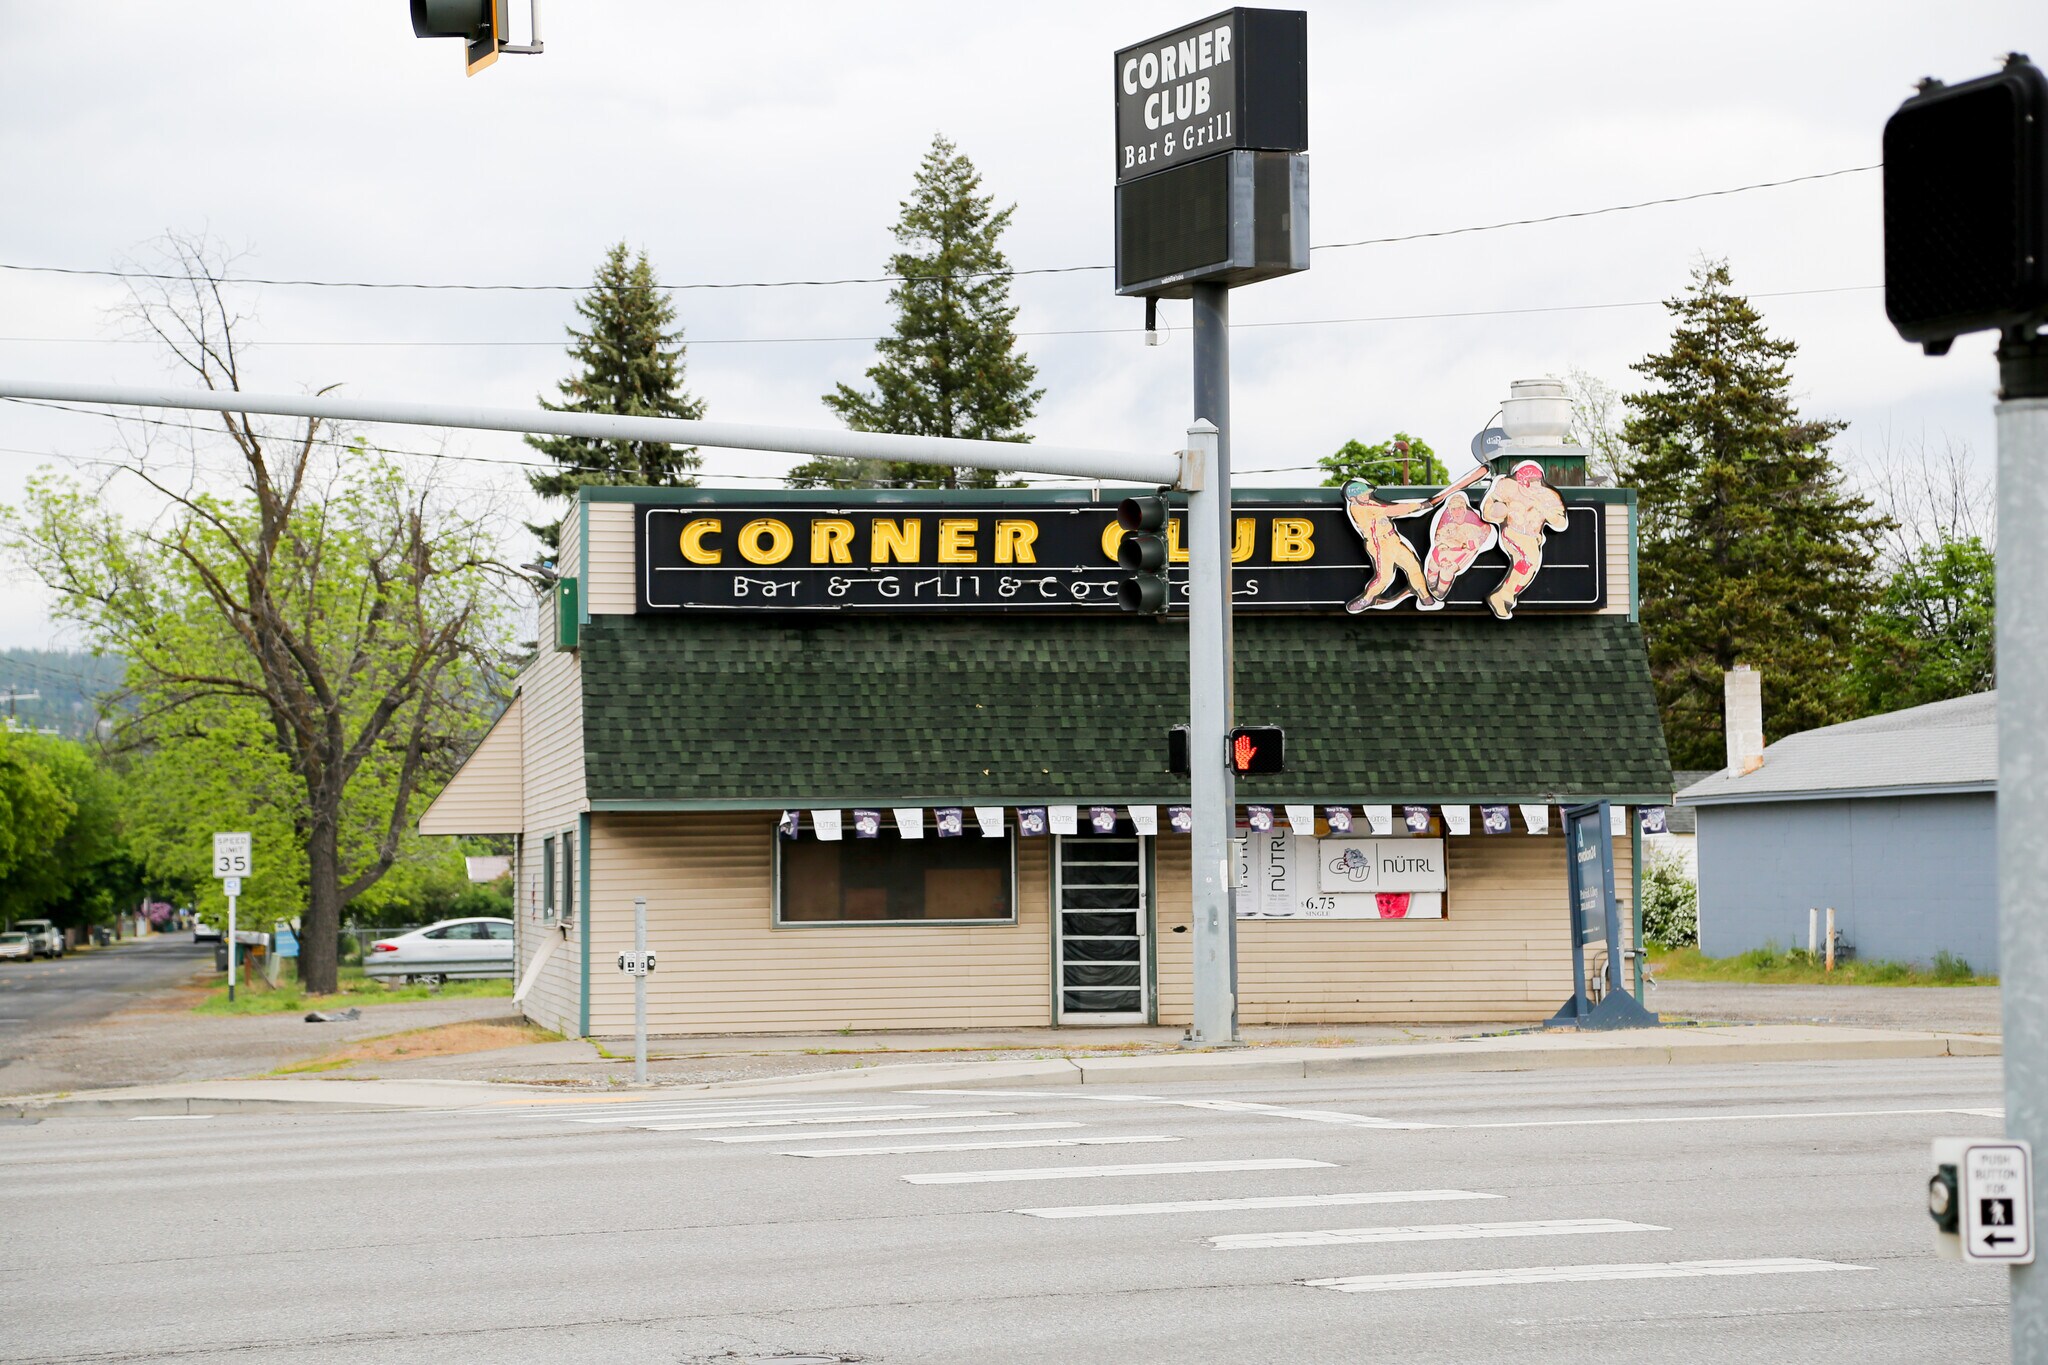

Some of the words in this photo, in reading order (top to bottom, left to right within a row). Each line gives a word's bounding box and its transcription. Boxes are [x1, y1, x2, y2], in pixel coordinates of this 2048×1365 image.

[1122, 25, 1232, 96] CORNER
[1144, 76, 1211, 130] CLUB
[1124, 141, 1158, 169] Bar
[1163, 132, 1176, 157] &
[1182, 111, 1232, 151] Grill
[680, 518, 1039, 565] CORNER
[734, 576, 801, 597] Bar
[827, 576, 851, 597] &
[999, 576, 1022, 597] &
[218, 837, 246, 845] SPEED
[219, 856, 246, 872] 35
[1329, 857, 1370, 882] GU
[1383, 855, 1434, 873] NÜTRL
[1301, 896, 1335, 910] $6.75
